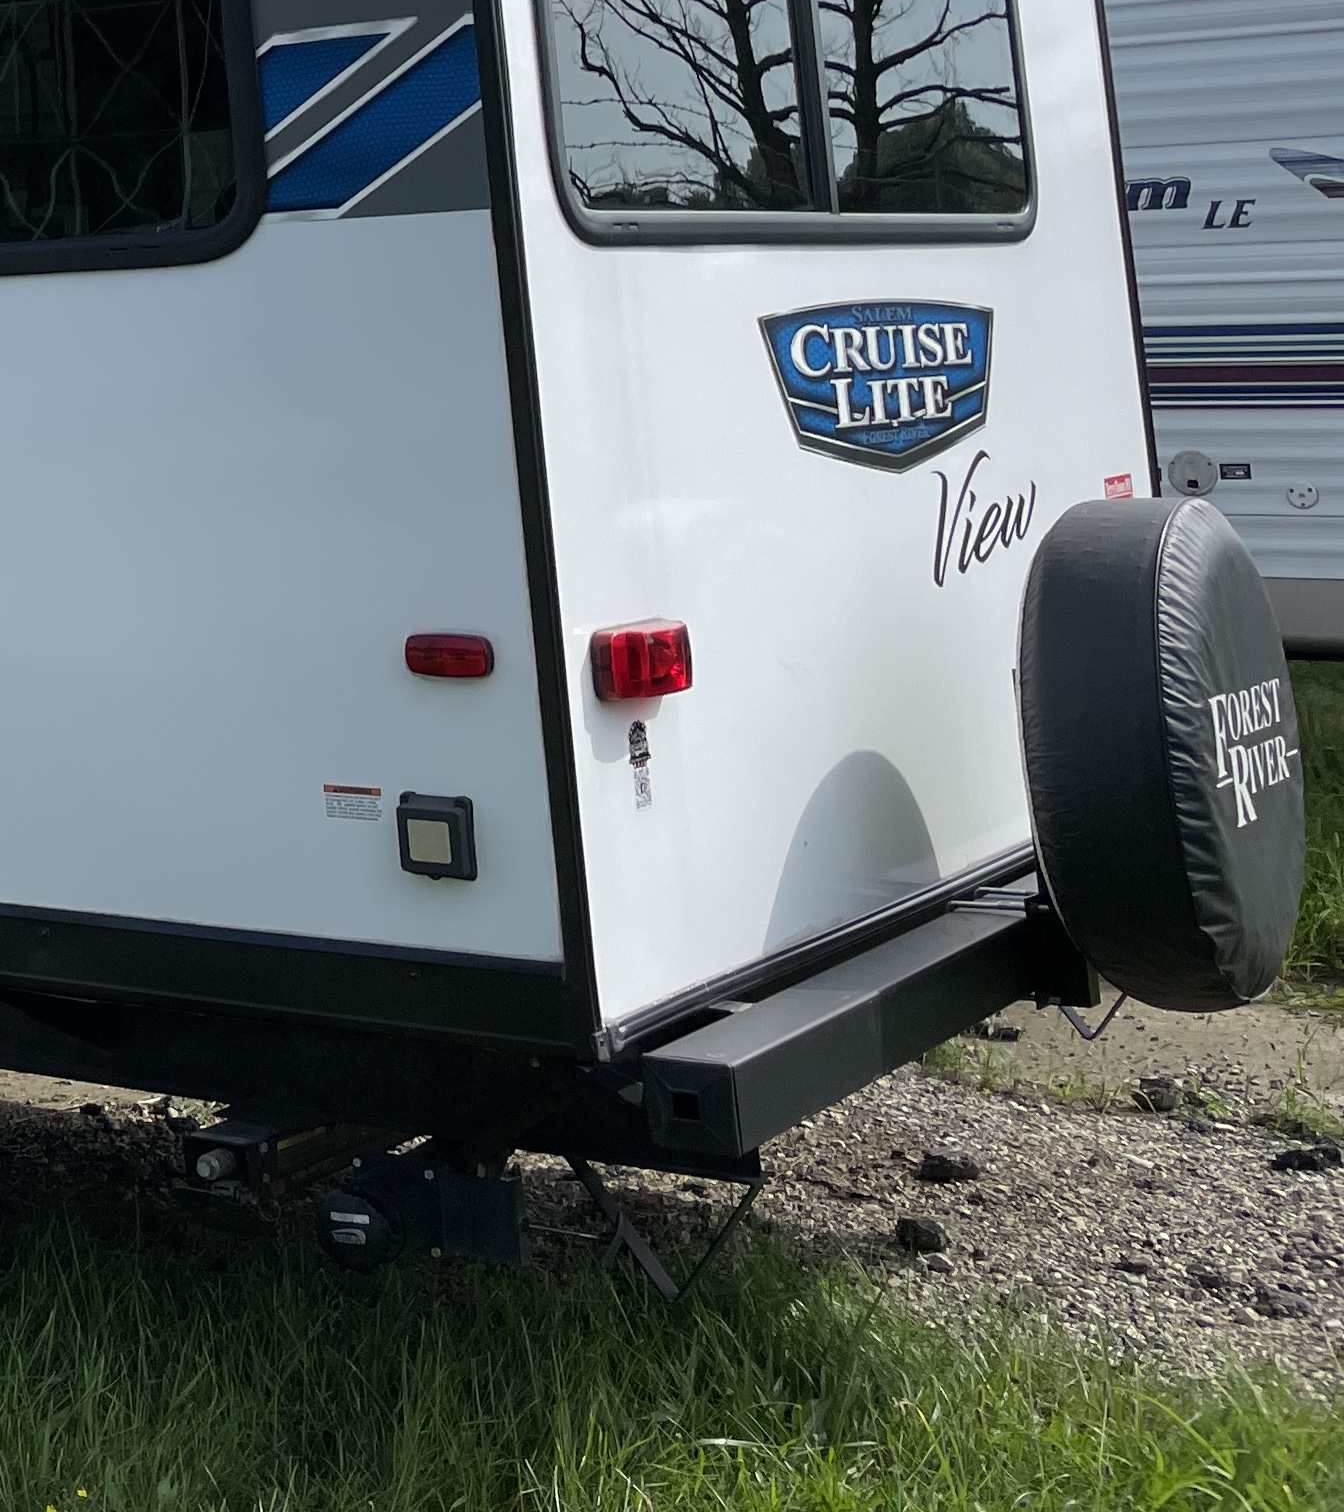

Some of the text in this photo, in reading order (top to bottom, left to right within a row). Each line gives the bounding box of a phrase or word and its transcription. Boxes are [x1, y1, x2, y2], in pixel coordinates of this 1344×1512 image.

[1201, 199, 1256, 230] LE
[850, 306, 913, 324] SALEM
[790, 322, 973, 378] CRUISE
[830, 375, 953, 429] LITE
[931, 449, 1036, 588] View
[1208, 678, 1281, 778] FOREST
